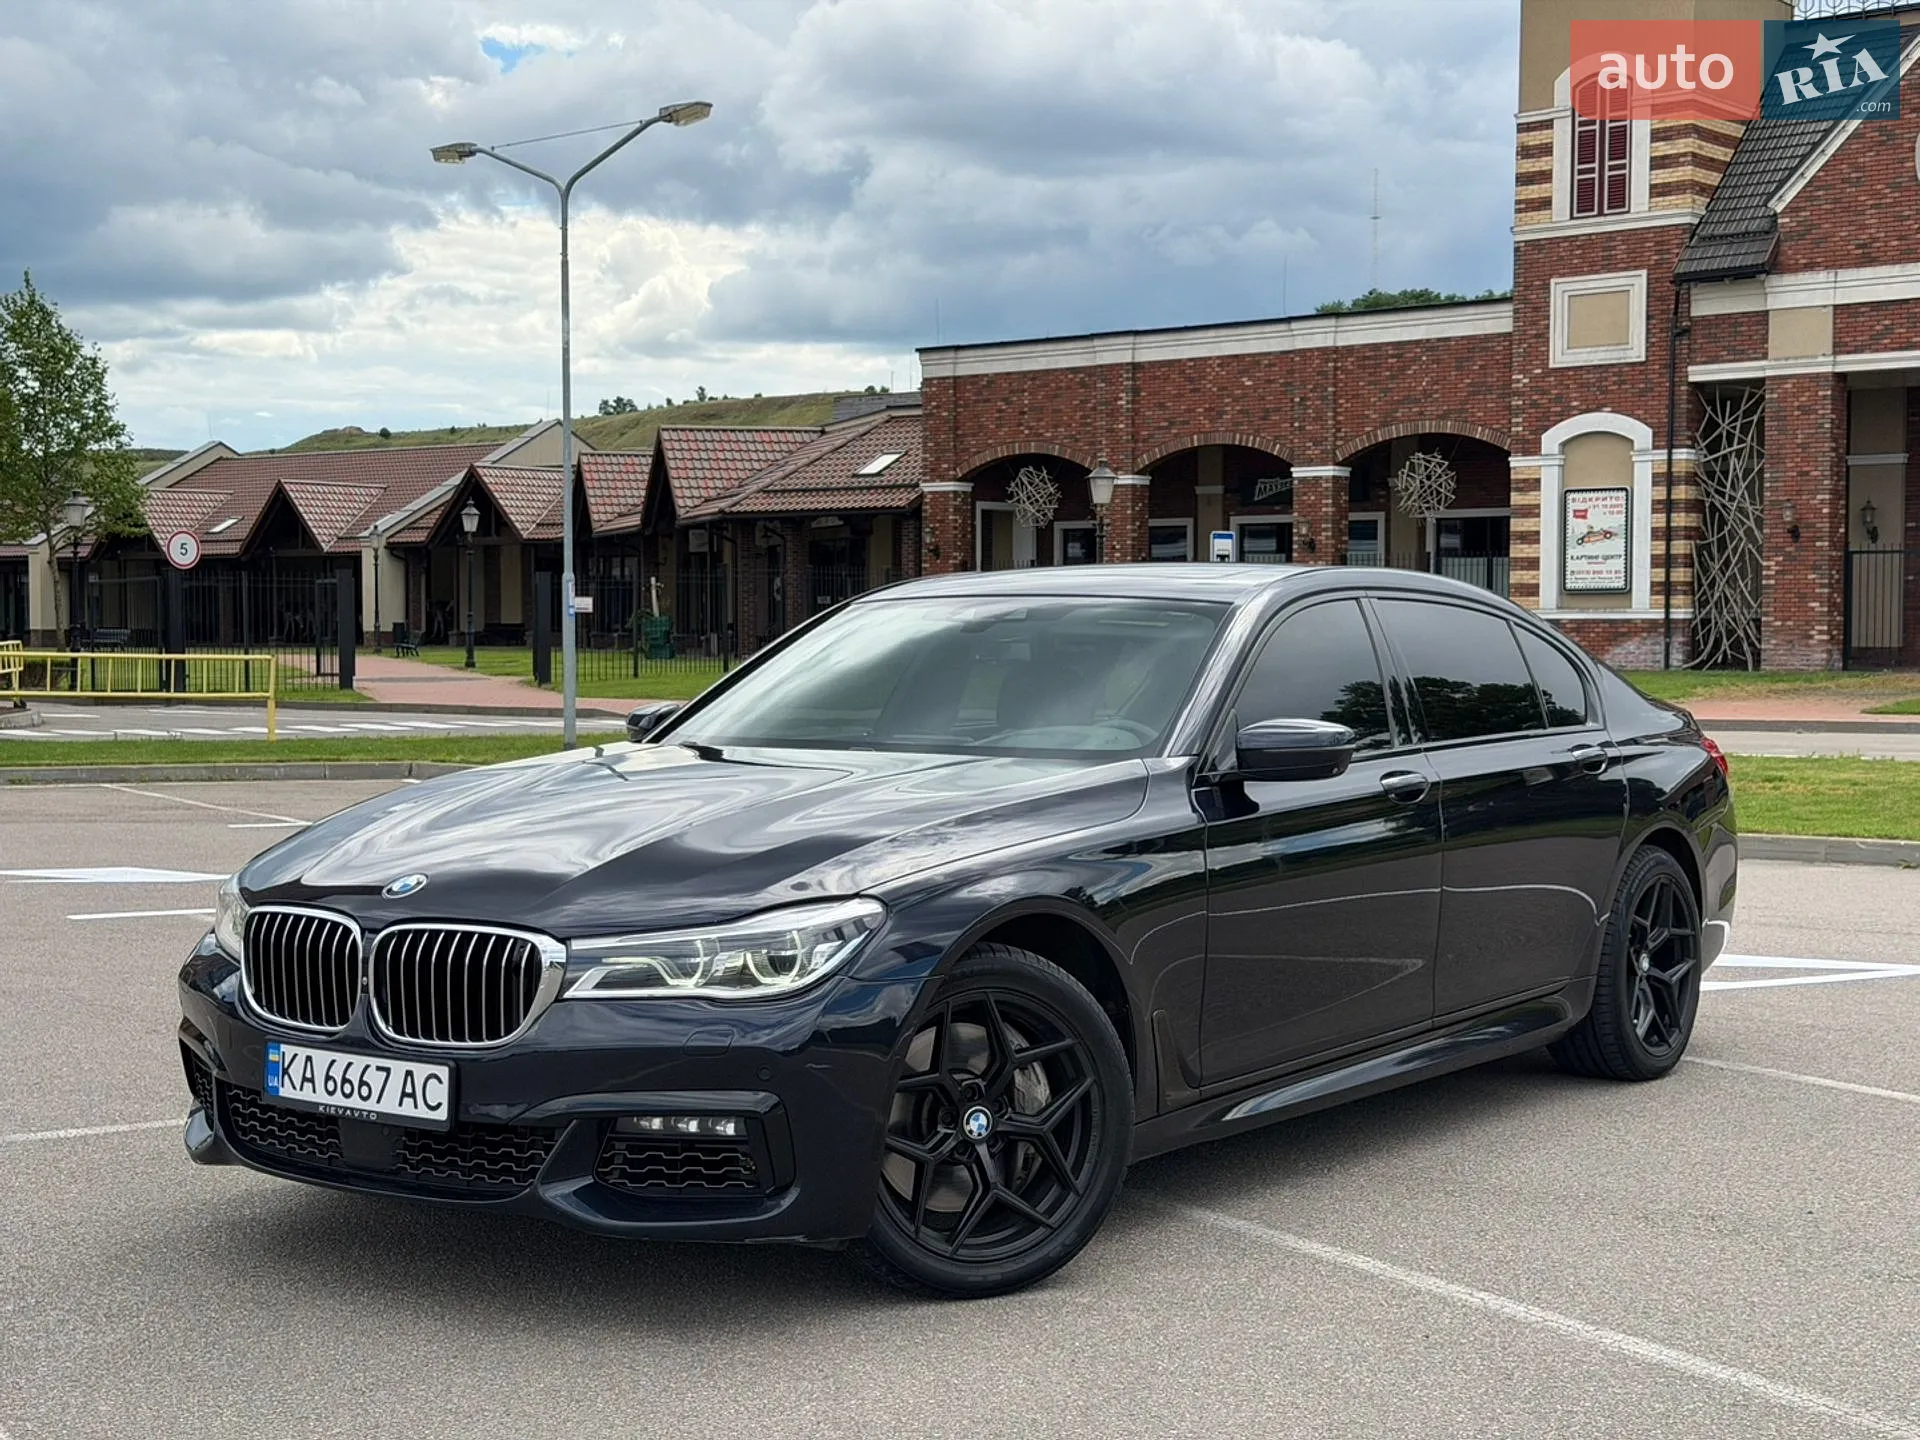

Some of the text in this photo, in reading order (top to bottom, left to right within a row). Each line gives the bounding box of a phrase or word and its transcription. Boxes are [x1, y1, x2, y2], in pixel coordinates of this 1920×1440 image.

[180, 542, 188, 557] 5
[267, 1075, 279, 1088] UA
[280, 1051, 444, 1112] KA 6667 AC
[317, 1104, 378, 1121] KIEVAVTO
